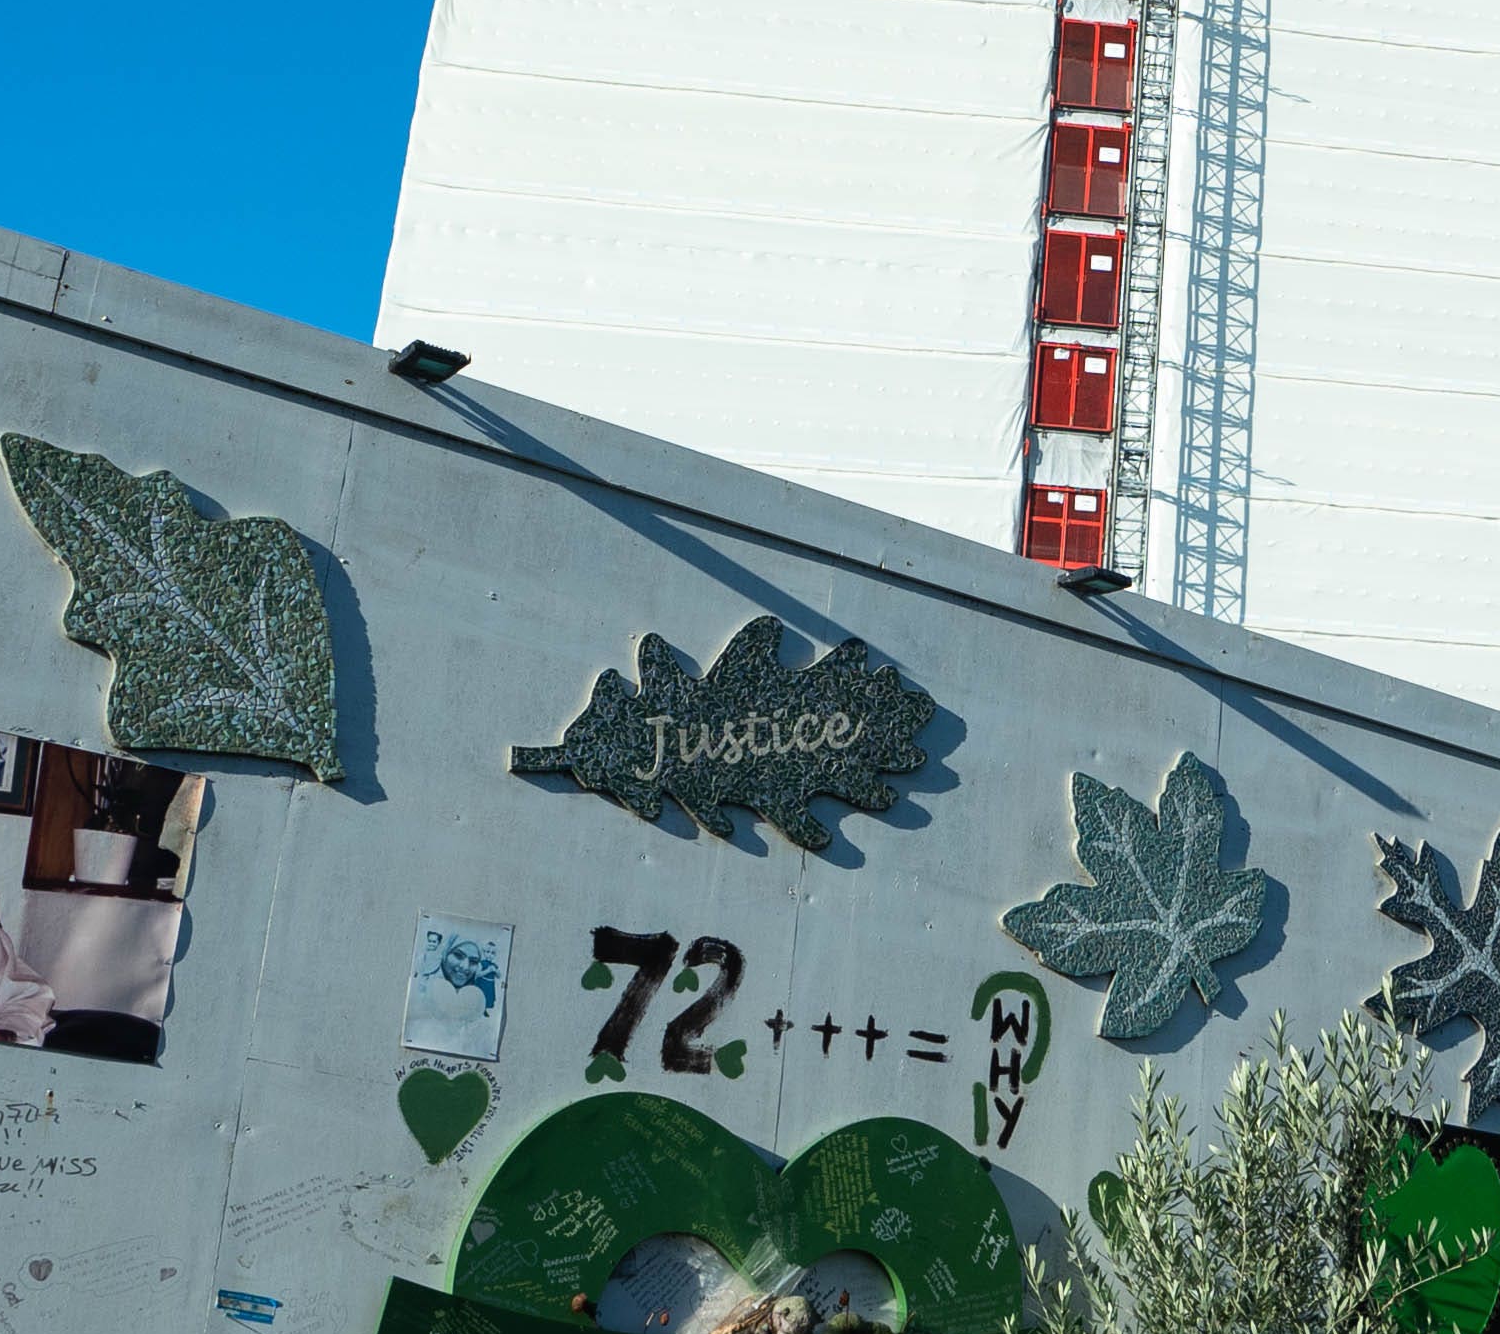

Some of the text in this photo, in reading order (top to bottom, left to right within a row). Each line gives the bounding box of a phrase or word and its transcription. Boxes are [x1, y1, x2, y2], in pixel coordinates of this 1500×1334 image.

[636, 711, 865, 780] Justice
[591, 925, 744, 1073] 72
[410, 1058, 430, 1068] OUR
[434, 1058, 471, 1075] HEARTS
[476, 1063, 502, 1102] FOREVER
